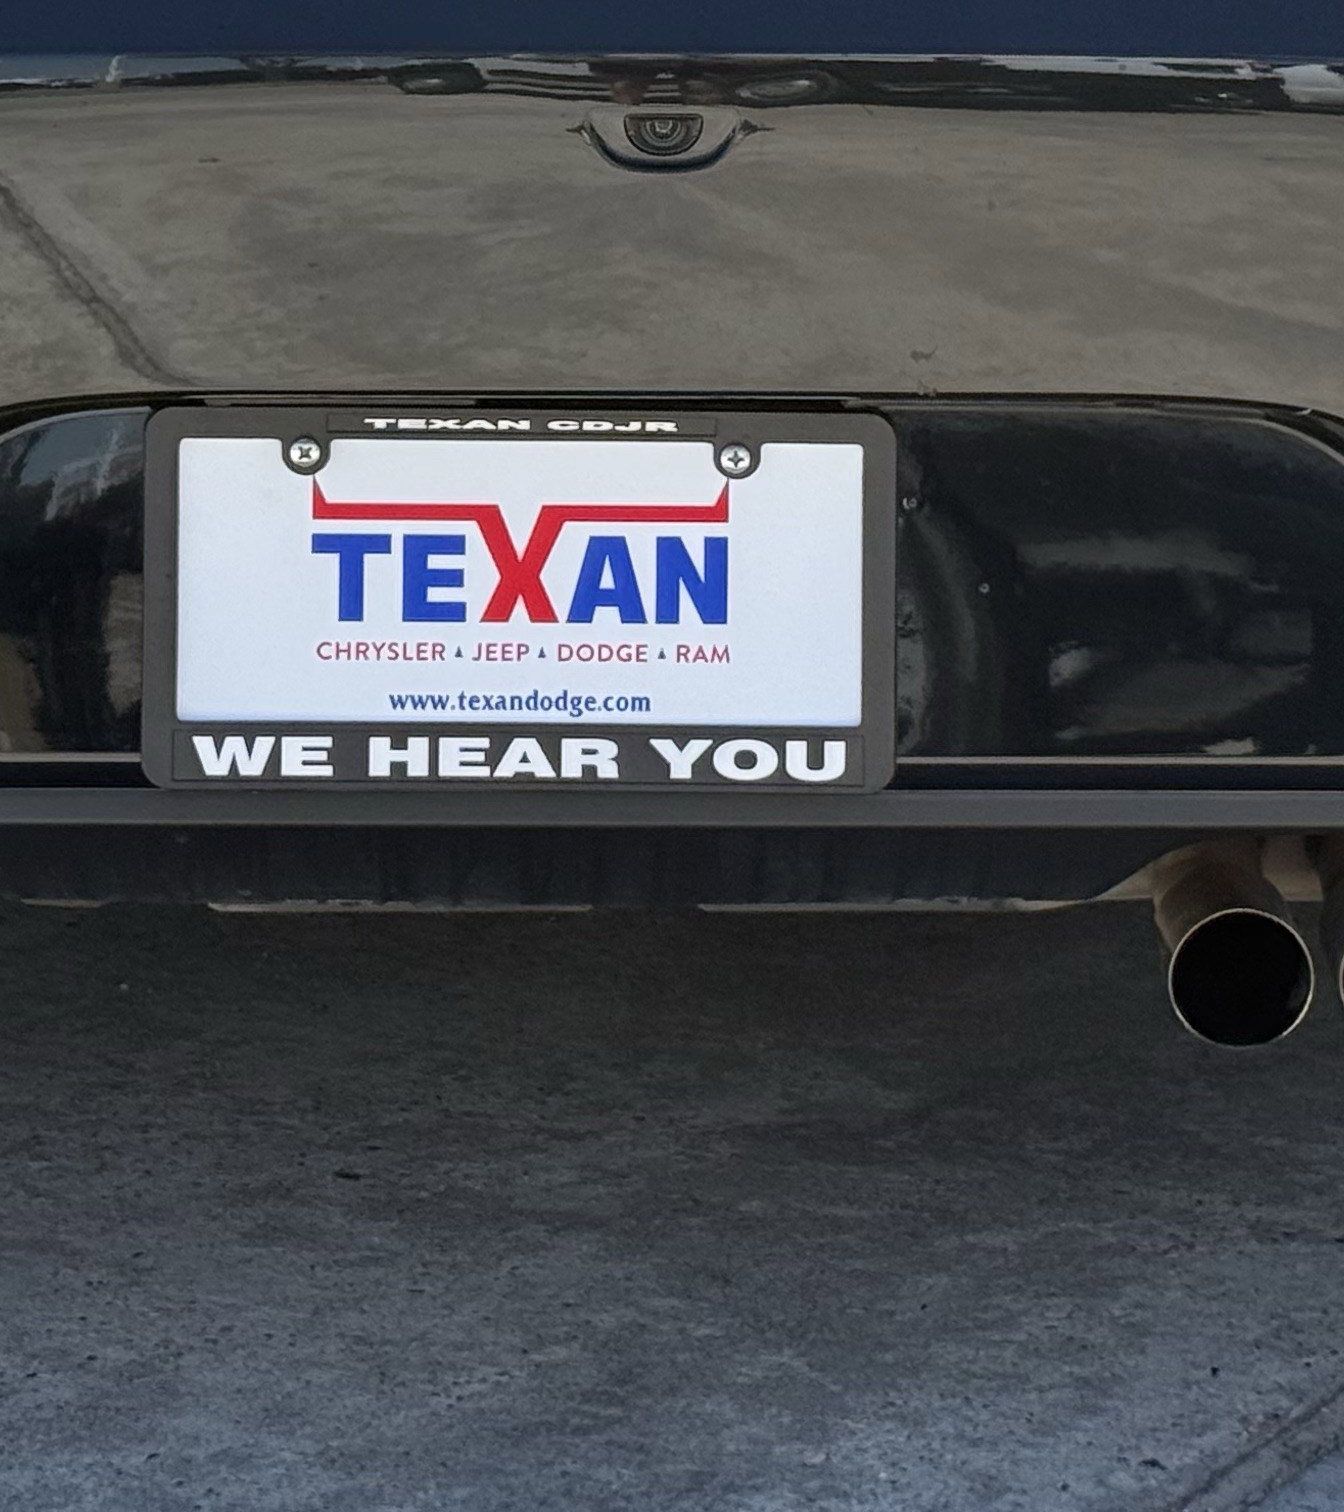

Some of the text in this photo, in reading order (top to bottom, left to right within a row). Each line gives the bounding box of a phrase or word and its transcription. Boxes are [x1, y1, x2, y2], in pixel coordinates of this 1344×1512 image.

[364, 417, 679, 433] TEXAN CDJR
[311, 505, 730, 625] TEXAN
[316, 641, 731, 664] CHRYSLER JEEP DODGE RAM
[389, 690, 652, 717] www.texandodge.com
[192, 735, 847, 783] WE HEAR YOU
